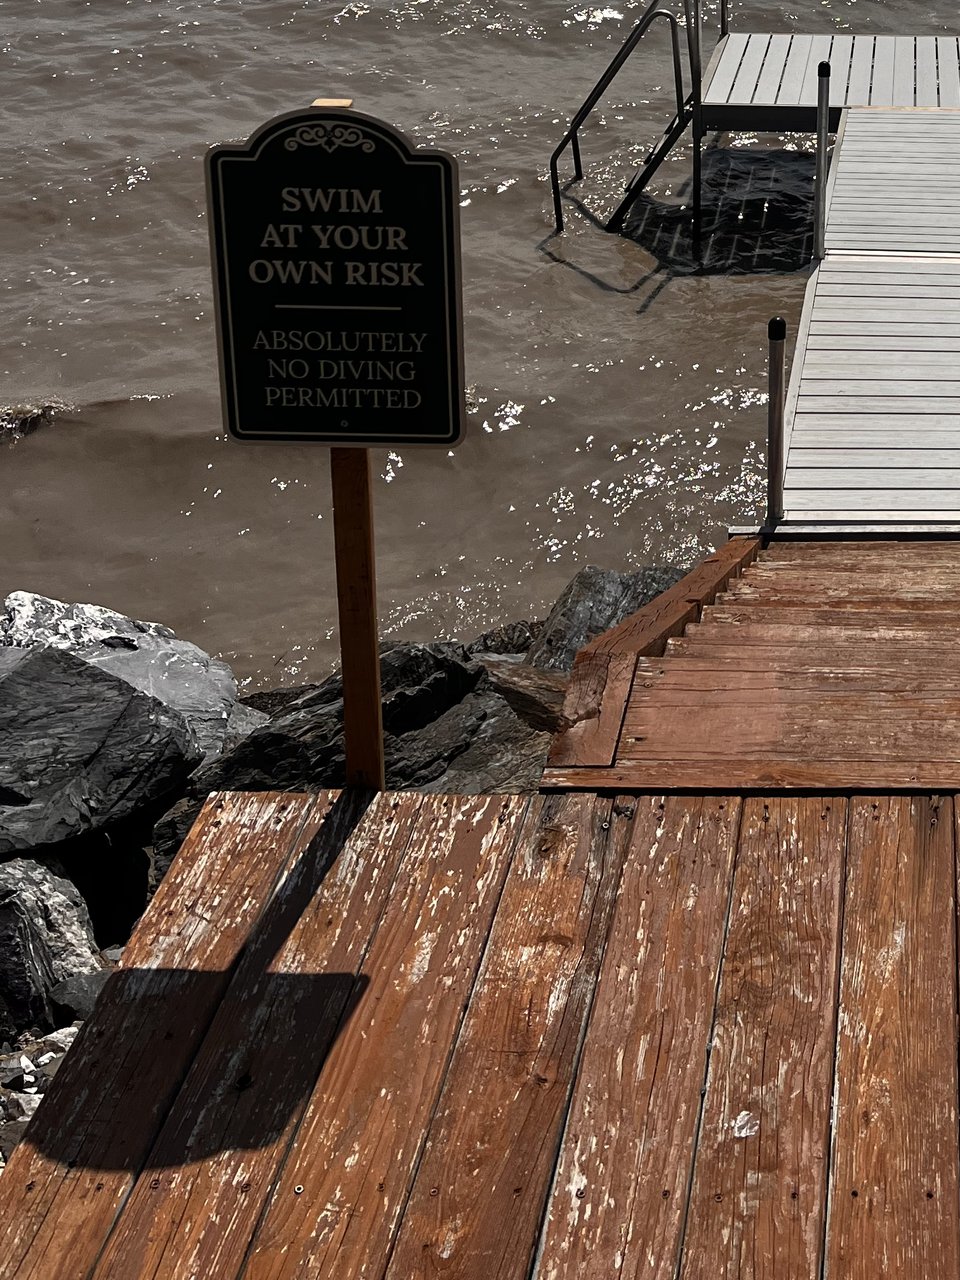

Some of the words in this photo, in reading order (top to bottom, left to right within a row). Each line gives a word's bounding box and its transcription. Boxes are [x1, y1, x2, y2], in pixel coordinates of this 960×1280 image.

[281, 187, 383, 213] SWIM
[260, 224, 303, 248] AT
[311, 225, 409, 251] YOUR
[248, 259, 333, 285] OWN
[344, 261, 425, 287] RISK
[253, 330, 428, 353] ABSOLUTELY
[267, 358, 309, 379] NO
[319, 360, 416, 381] DIVING
[265, 387, 422, 409] PERMITTED
